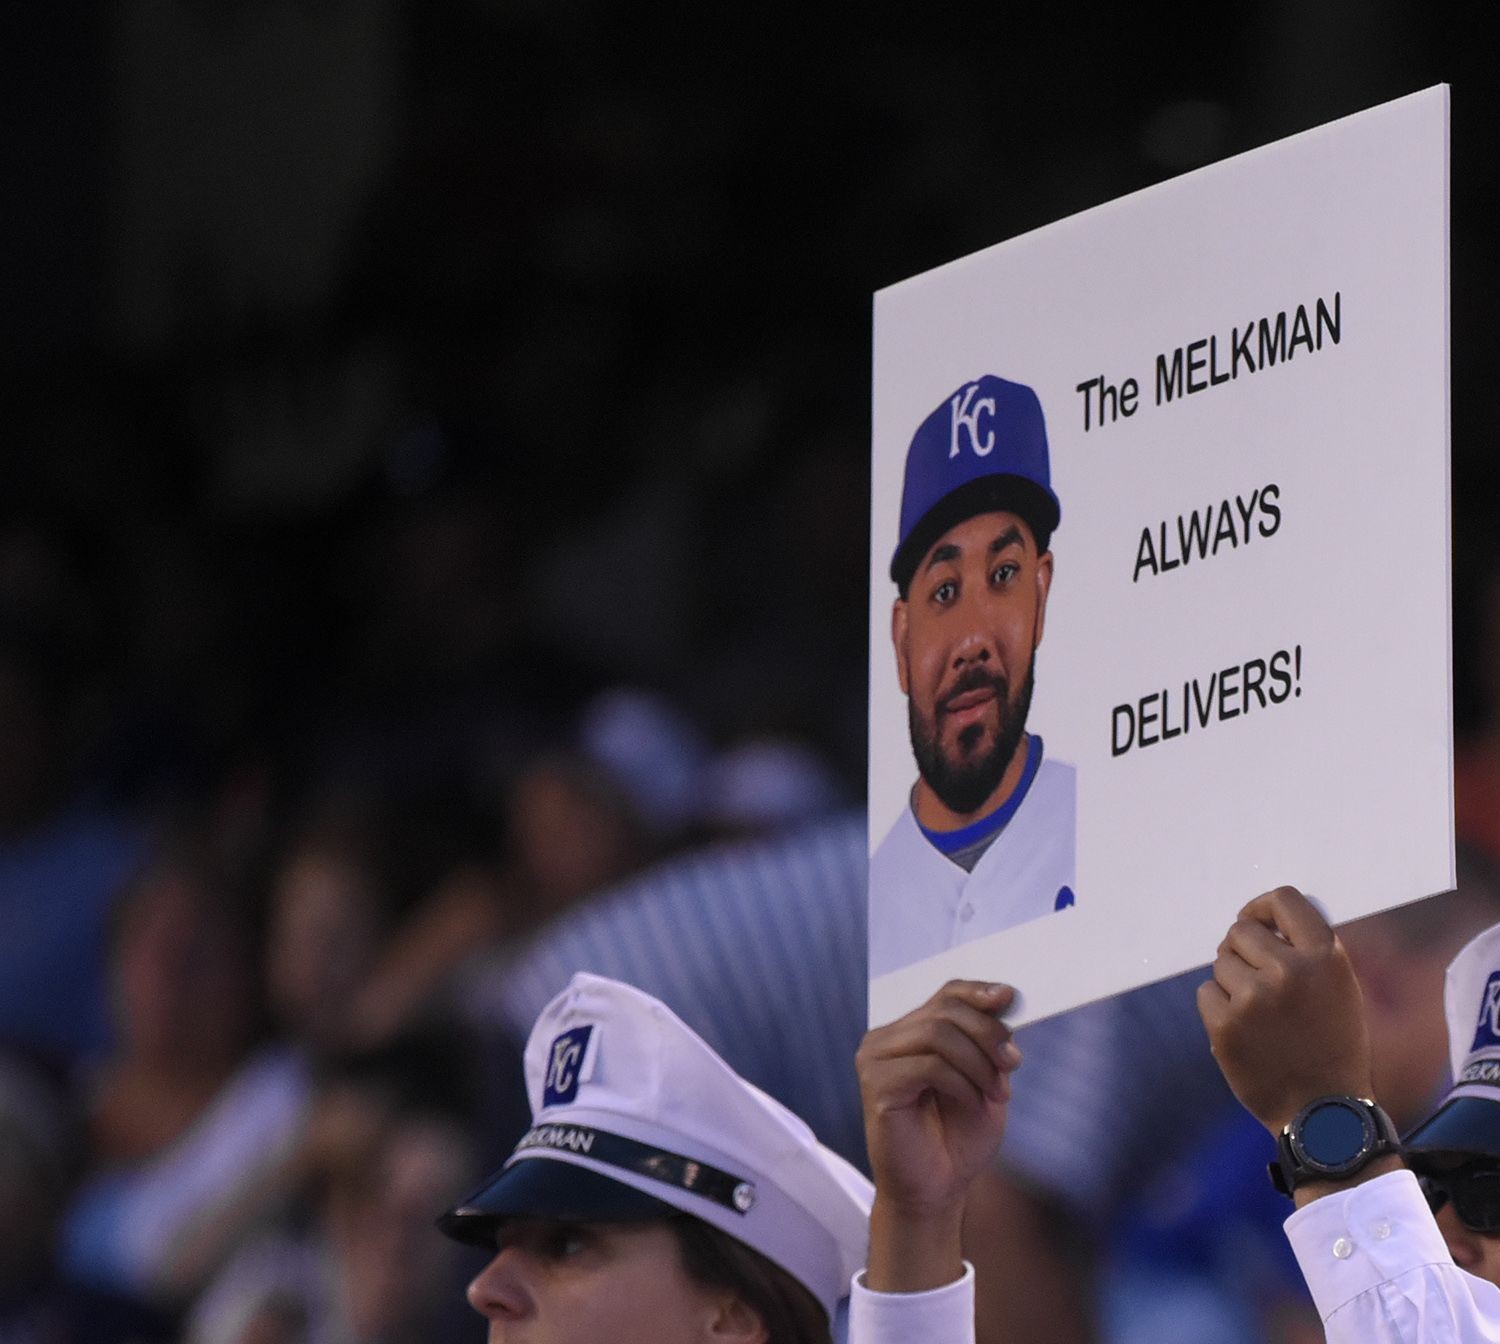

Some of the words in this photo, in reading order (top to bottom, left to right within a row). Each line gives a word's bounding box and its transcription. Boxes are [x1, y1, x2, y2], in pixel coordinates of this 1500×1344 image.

[1076, 374, 1139, 432] The
[1156, 291, 1341, 406] MELKMAN
[948, 384, 996, 459] KC
[1133, 483, 1281, 583] ALWAYS
[1112, 644, 1302, 758] DELIVERS!
[546, 1036, 582, 1094] KC
